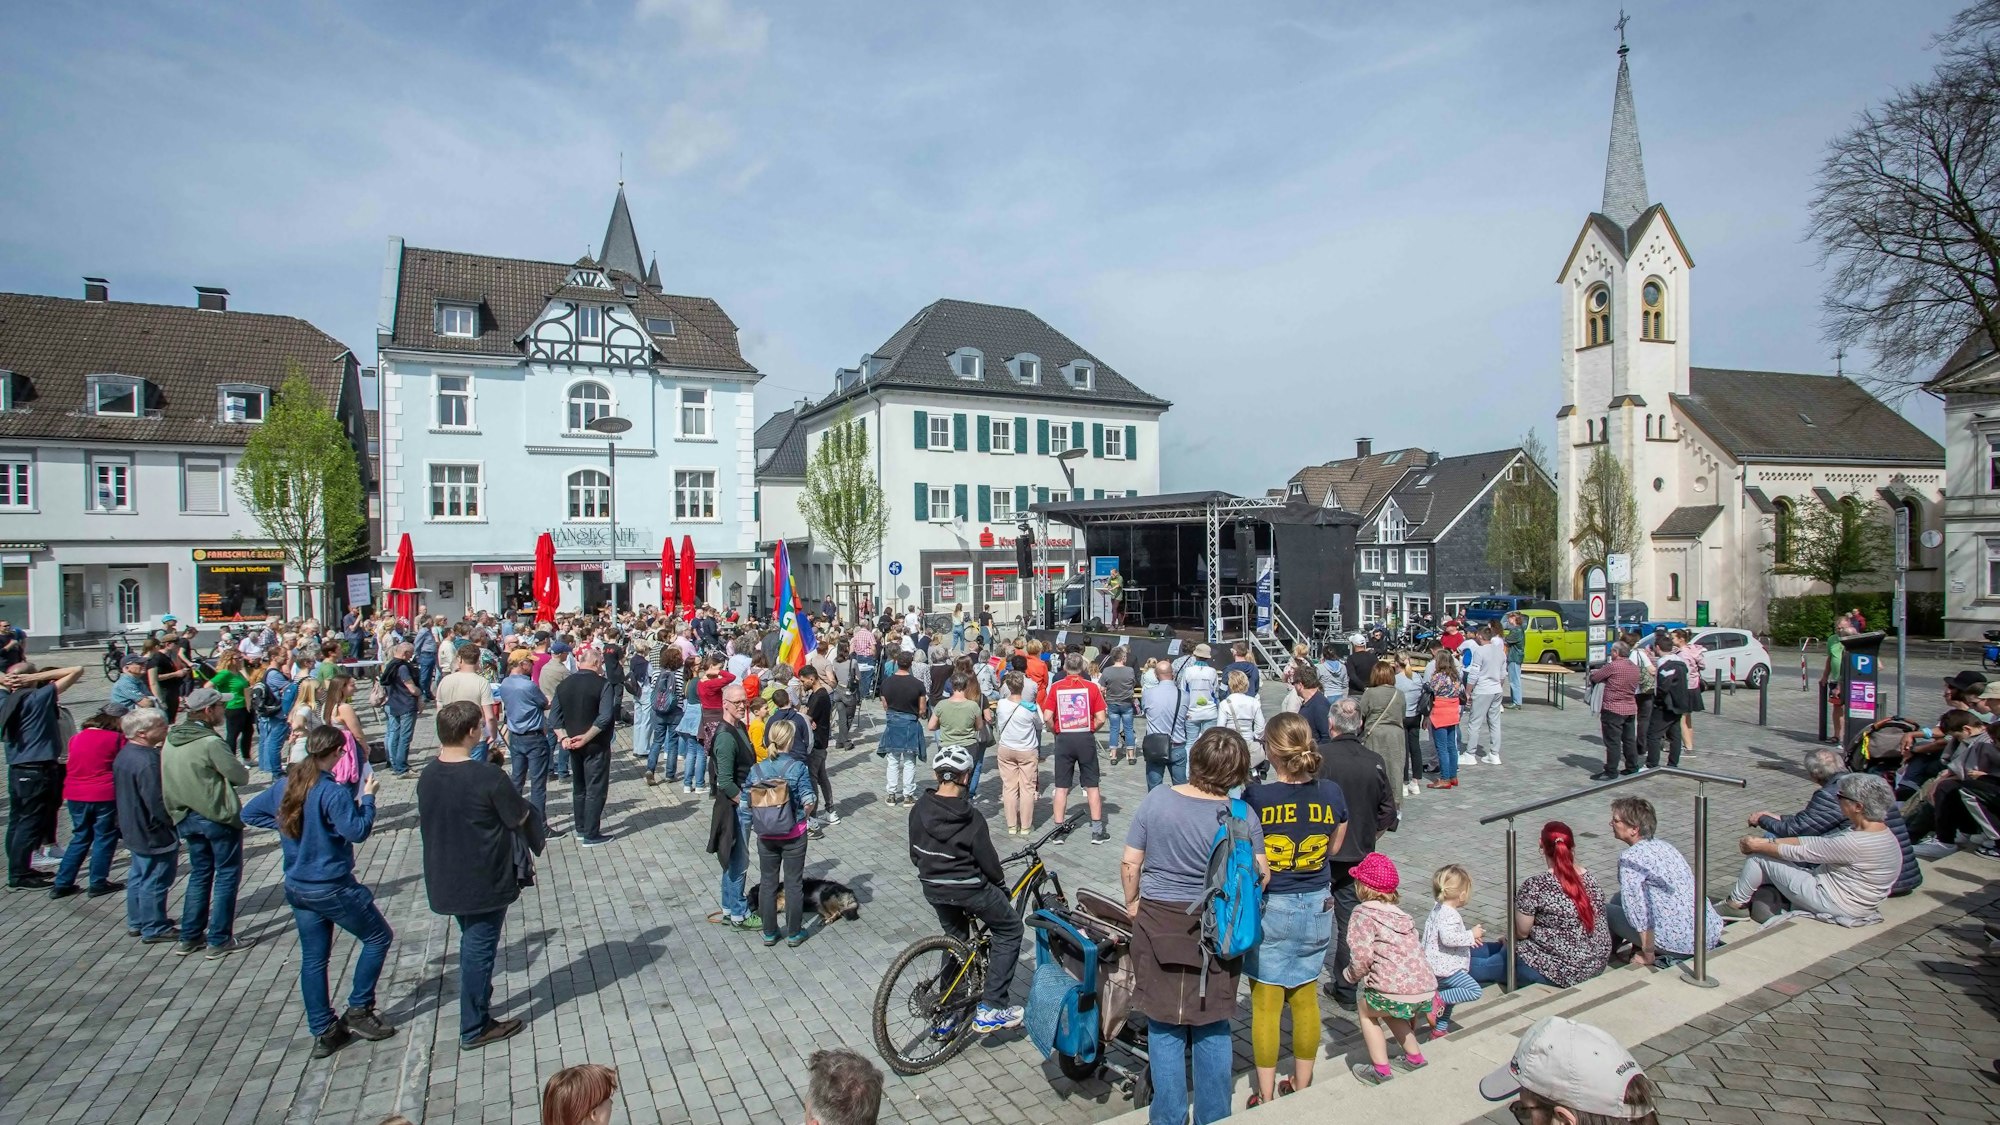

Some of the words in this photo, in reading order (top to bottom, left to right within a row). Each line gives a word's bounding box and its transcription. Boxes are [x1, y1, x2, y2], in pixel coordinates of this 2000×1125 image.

[1857, 655, 1870, 670] P
[1261, 803, 1297, 825] DIE
[1308, 803, 1335, 825] DA
